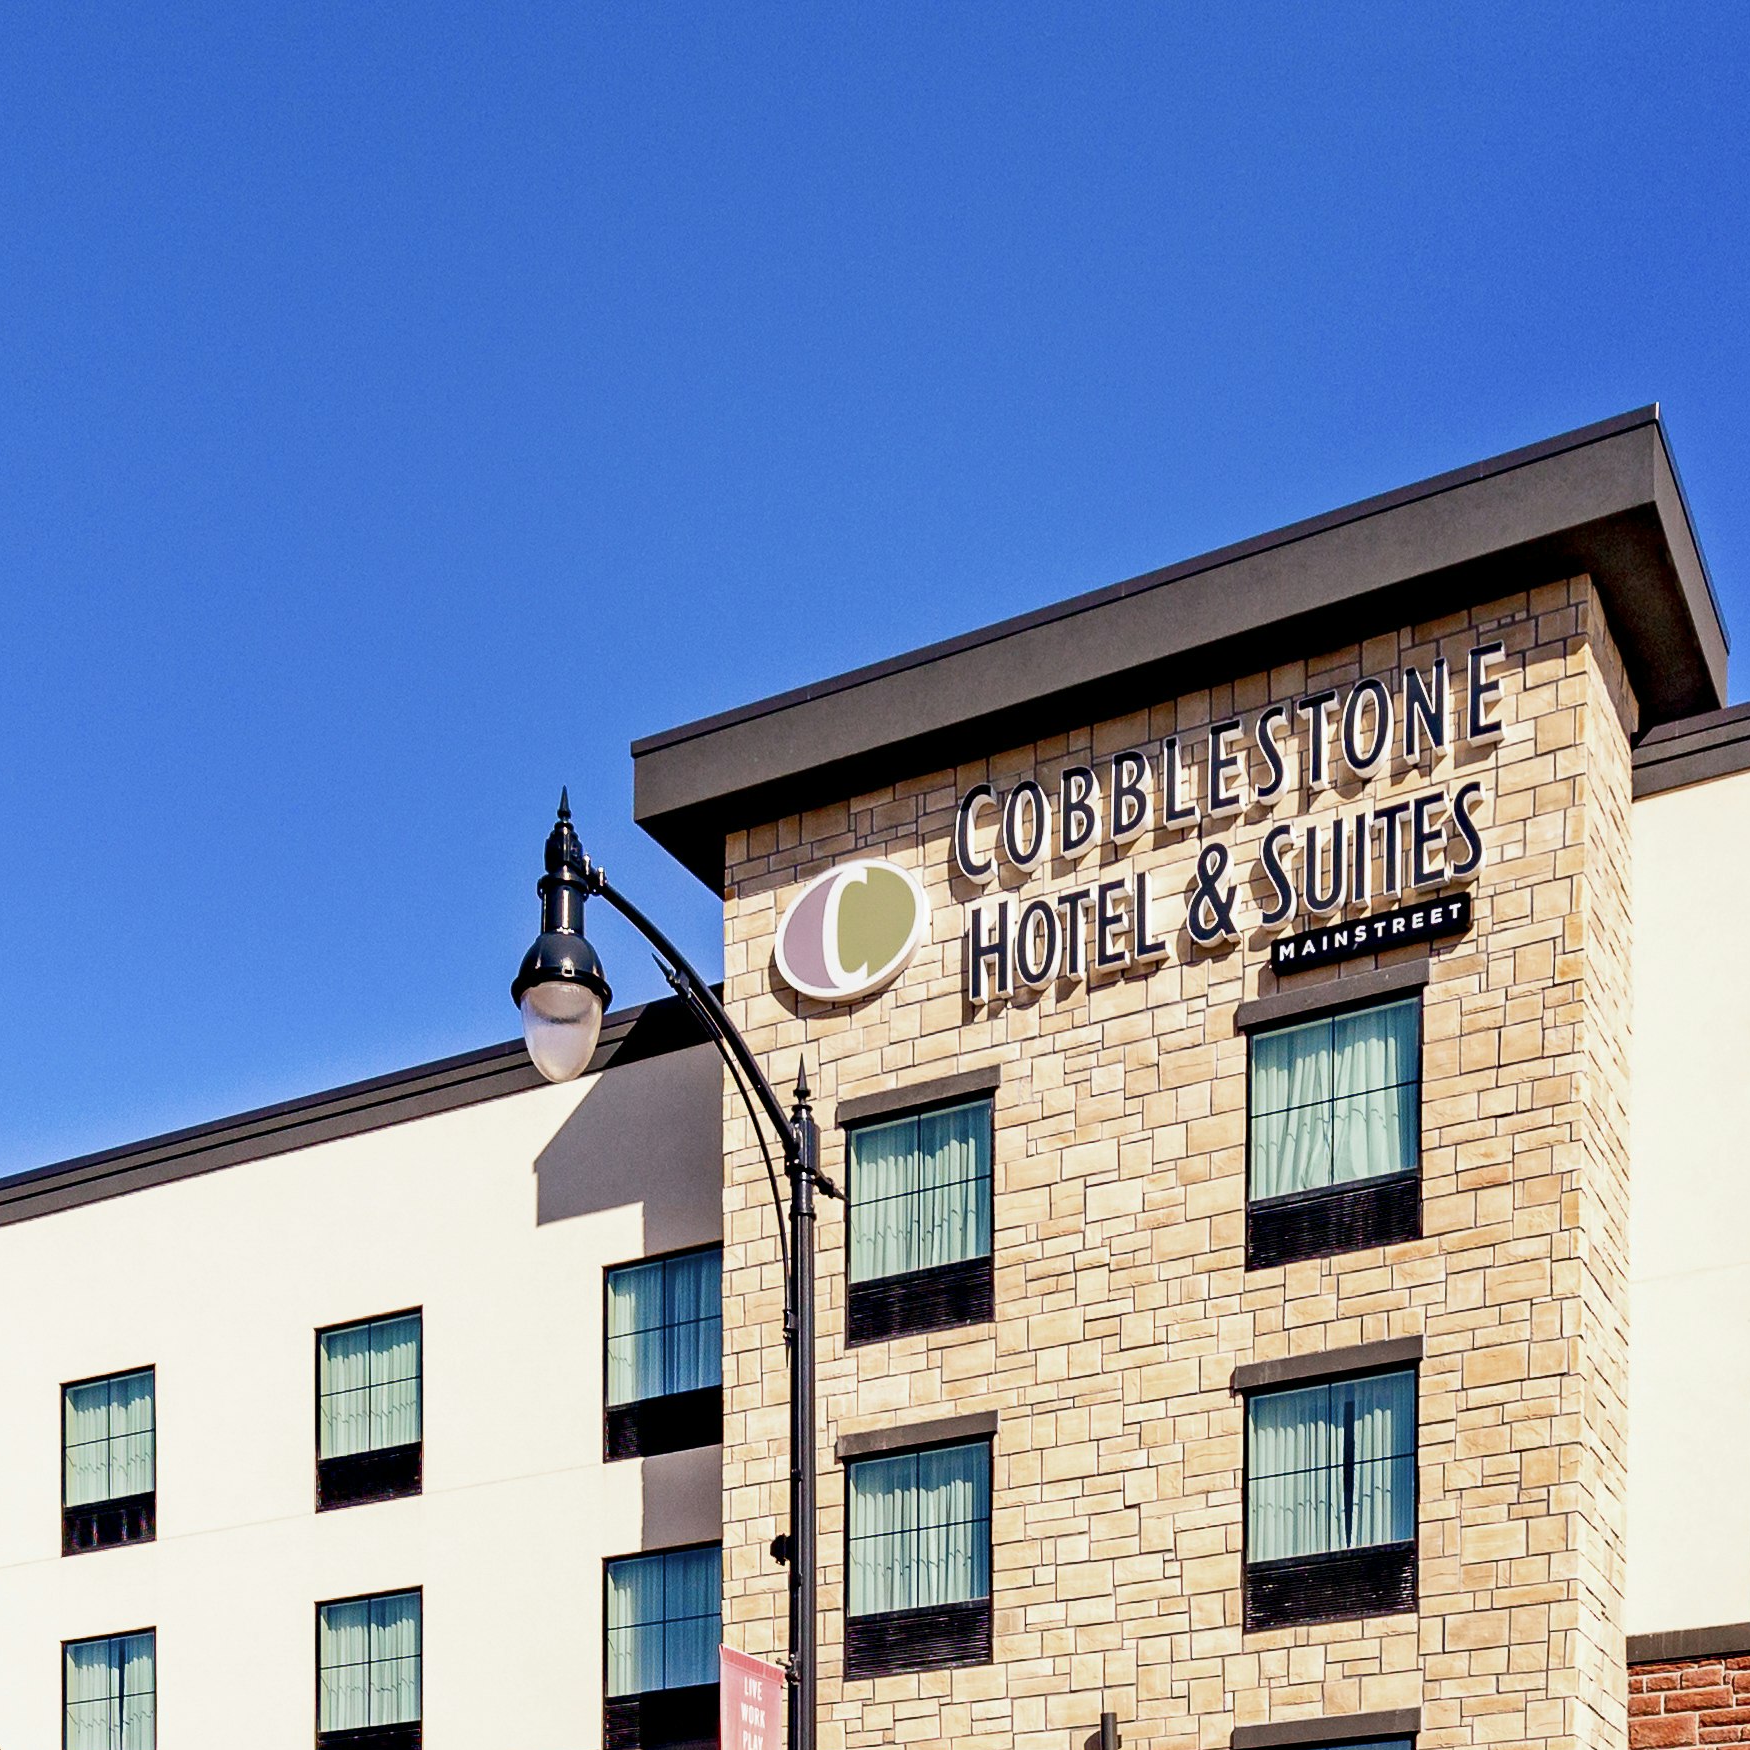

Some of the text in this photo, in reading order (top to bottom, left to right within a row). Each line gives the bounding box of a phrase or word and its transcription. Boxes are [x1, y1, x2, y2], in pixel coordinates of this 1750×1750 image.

[954, 641, 1507, 883] COBBLESTONE
[967, 781, 1486, 1005] HOTEL & SUITES
[1279, 902, 1462, 962] MAINSTREET
[740, 1702, 766, 1729] WORK
[744, 1676, 763, 1701] LIVE
